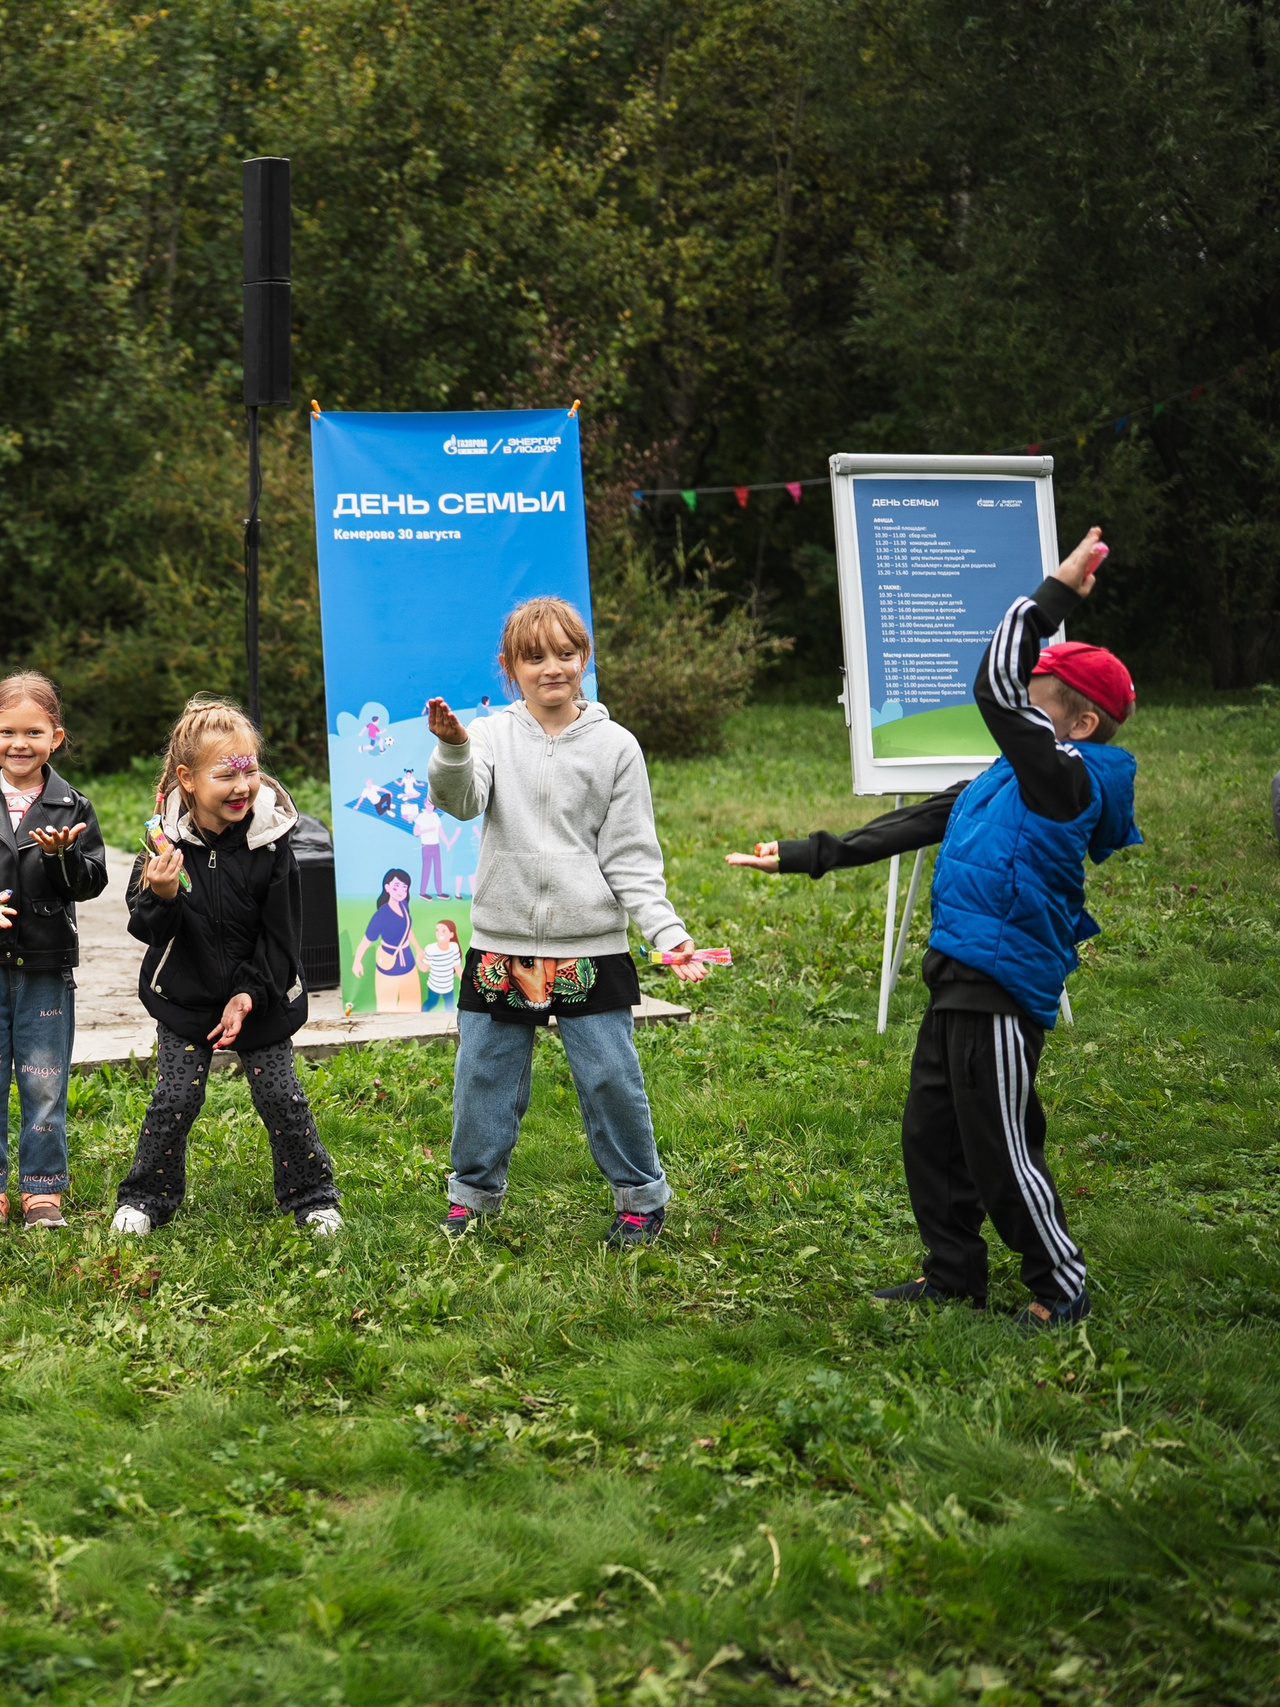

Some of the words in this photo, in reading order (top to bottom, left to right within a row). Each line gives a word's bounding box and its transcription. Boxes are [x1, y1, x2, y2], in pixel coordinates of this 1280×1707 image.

[458, 438, 488, 448] ГАЗПРОМ
[508, 436, 562, 446] ЭНЕРГИЯ
[502, 446, 512, 454] В
[513, 444, 557, 454] ЛЮДЯХ
[332, 493, 430, 518] ДЕНЬ
[438, 490, 566, 515] СЕМЬИ
[872, 498, 901, 507] ДЕНЬ
[902, 498, 939, 506] СЕМЬИ
[333, 528, 395, 541] Кемерово
[398, 528, 414, 540] 30
[416, 530, 461, 542] августа
